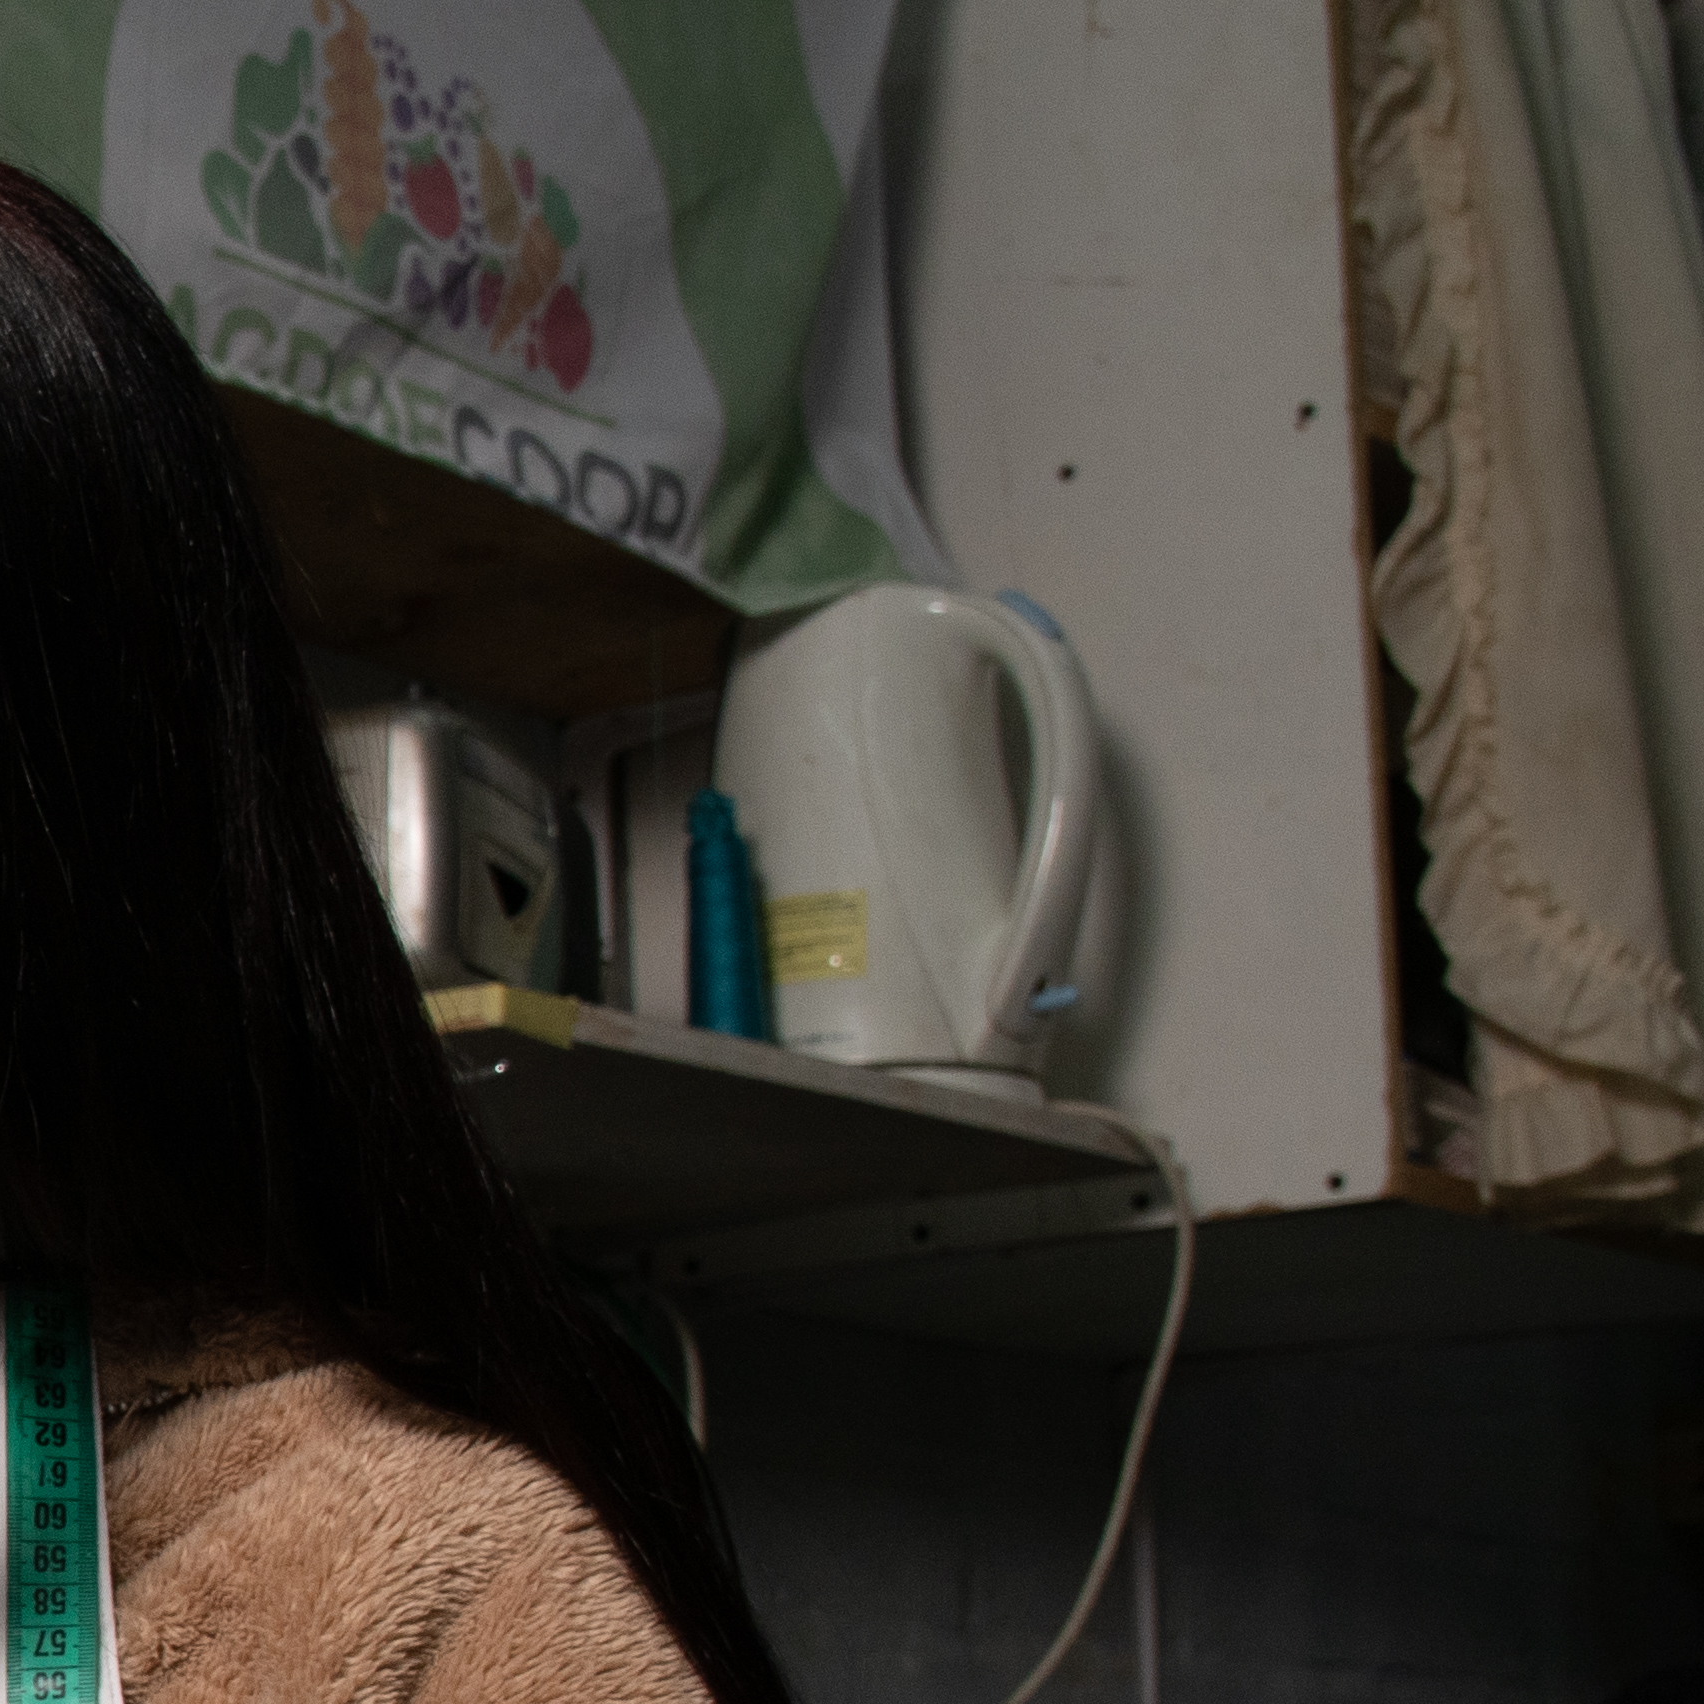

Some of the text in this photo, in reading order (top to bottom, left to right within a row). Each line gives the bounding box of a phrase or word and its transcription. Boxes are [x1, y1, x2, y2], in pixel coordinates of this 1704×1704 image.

[40, 1460, 67, 1489] 61
[33, 1502, 67, 1530] 60
[33, 1545, 67, 1573] 59
[32, 1587, 67, 1615] 58
[32, 1629, 67, 1657] 57
[32, 1671, 67, 1701] 56
